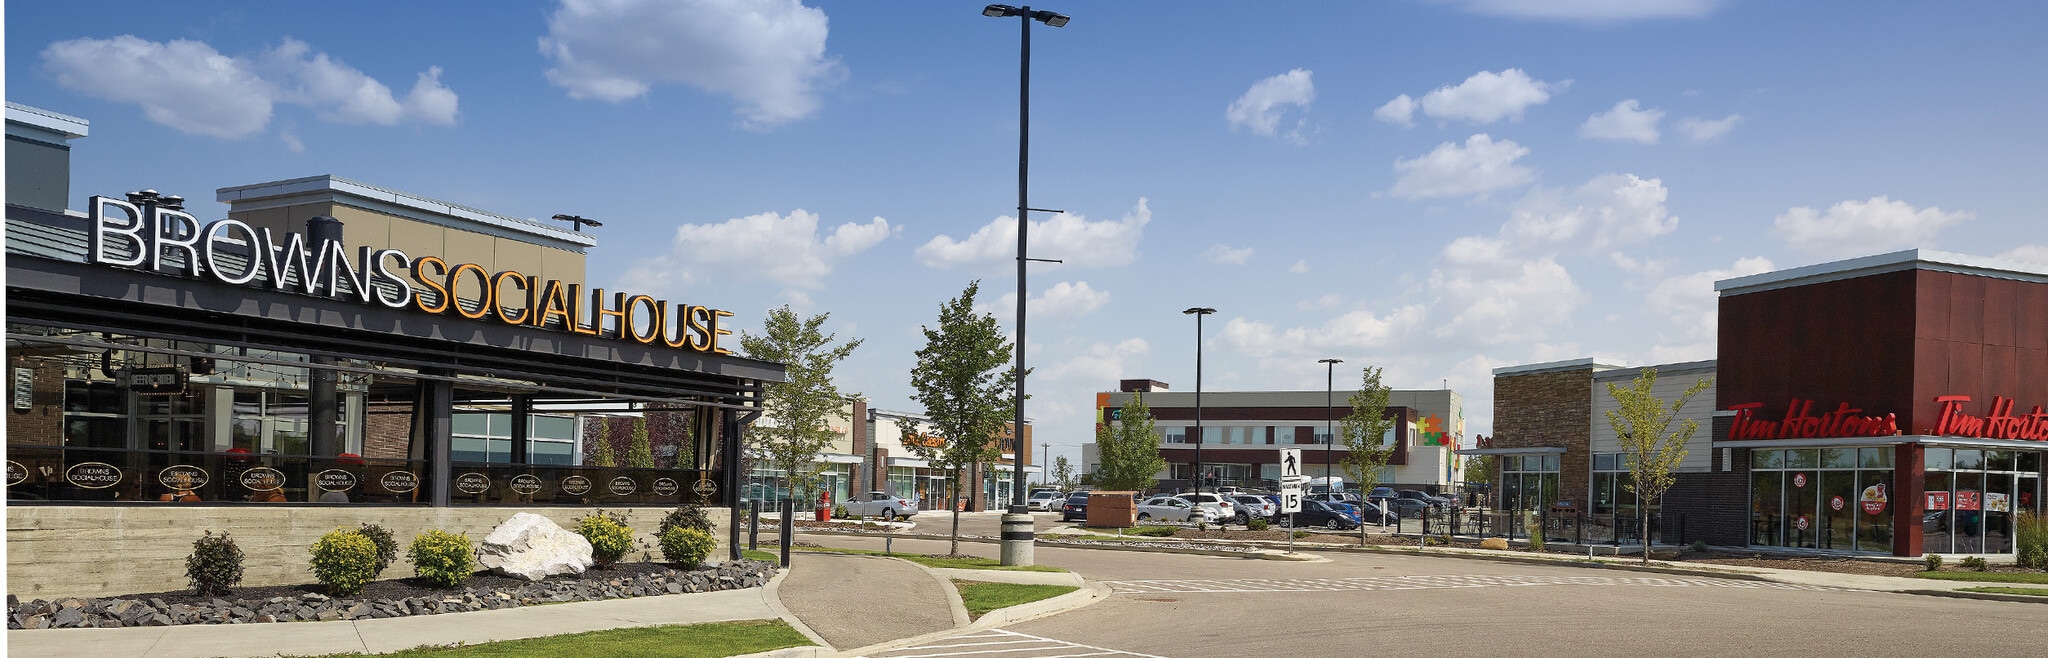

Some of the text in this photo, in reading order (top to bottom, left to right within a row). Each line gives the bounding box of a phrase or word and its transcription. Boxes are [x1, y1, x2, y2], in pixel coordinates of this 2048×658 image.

[1727, 397, 1897, 440] Tim Hortons
[1932, 394, 1984, 437] Tim
[1285, 494, 1298, 509] 15
